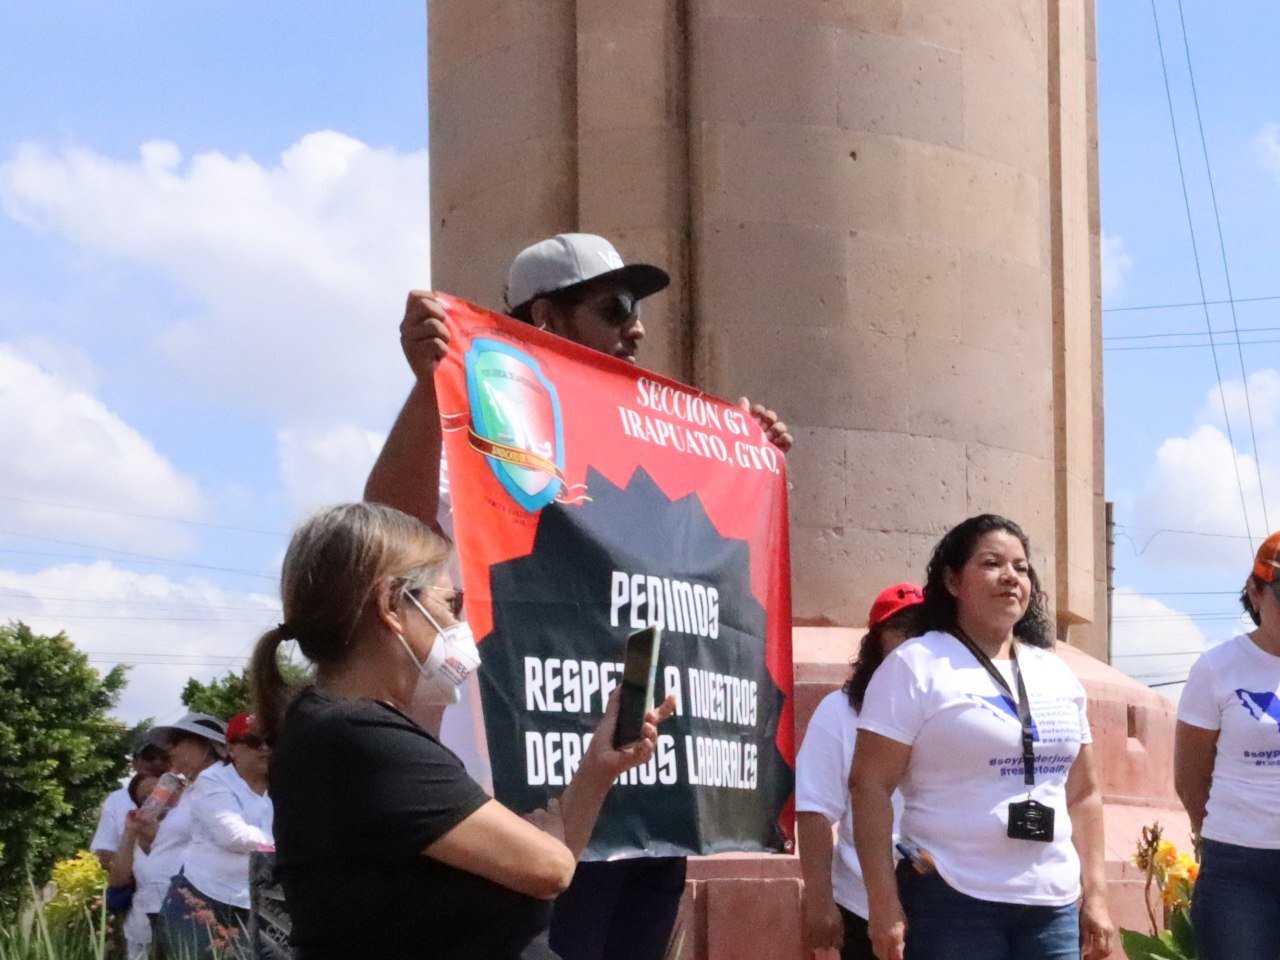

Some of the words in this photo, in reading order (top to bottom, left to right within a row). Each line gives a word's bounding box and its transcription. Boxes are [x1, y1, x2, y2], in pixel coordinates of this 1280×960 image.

[618, 406, 734, 467] IRAPUATO,
[735, 441, 781, 475] GTO.
[723, 408, 750, 436] 67
[610, 571, 719, 639] PEDIMOS
[524, 656, 625, 714] RESPE
[664, 665, 684, 716] A
[688, 667, 757, 727] NUESTROS
[525, 731, 678, 786] DEROS
[685, 735, 758, 790] LABORALES
